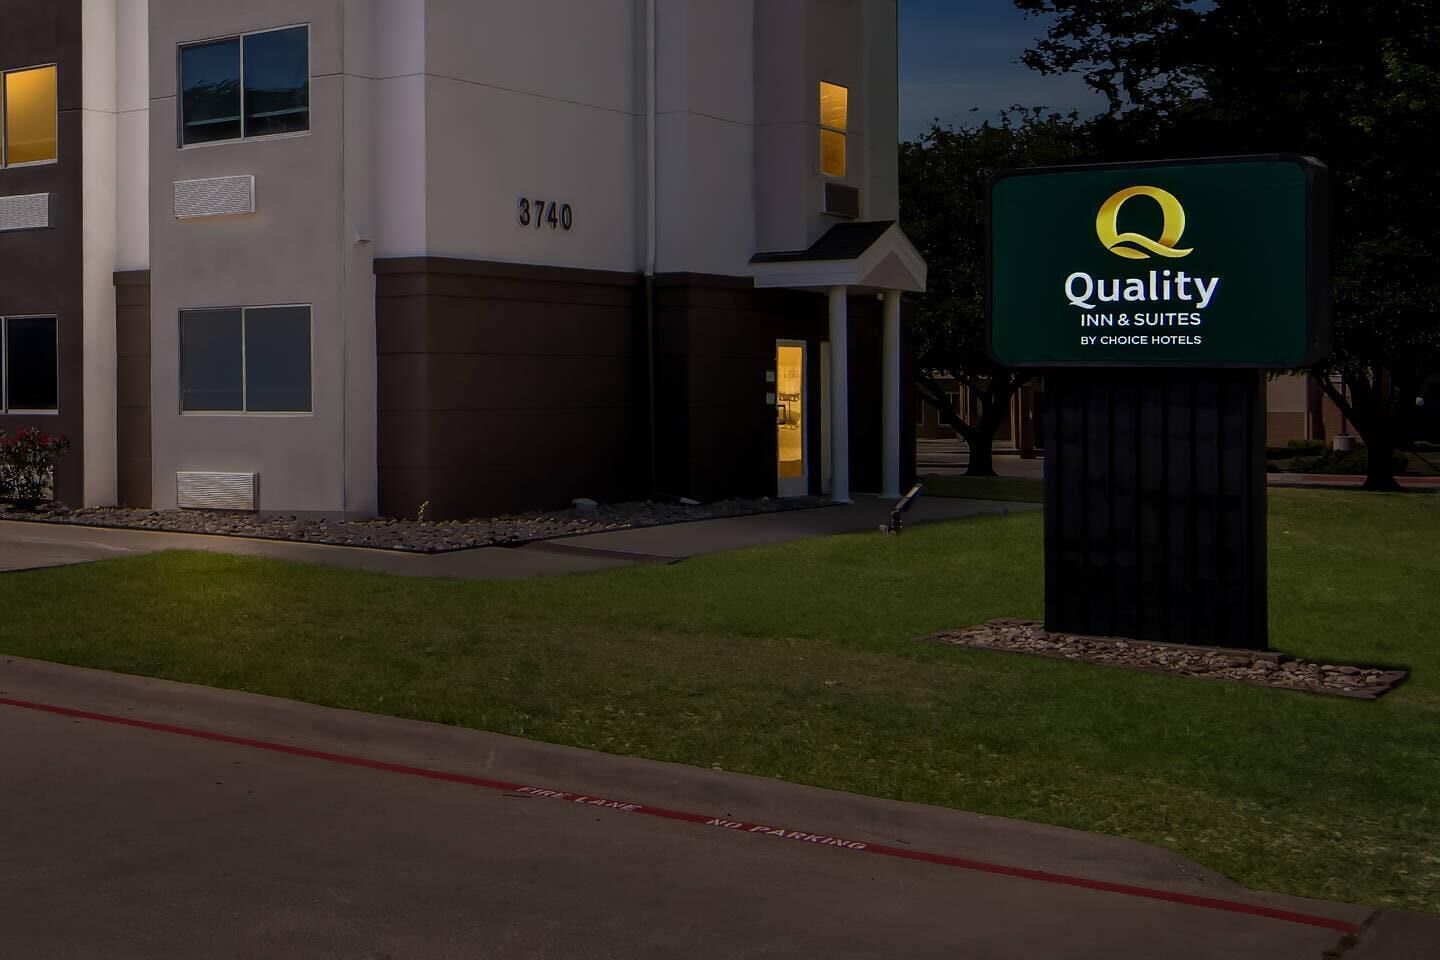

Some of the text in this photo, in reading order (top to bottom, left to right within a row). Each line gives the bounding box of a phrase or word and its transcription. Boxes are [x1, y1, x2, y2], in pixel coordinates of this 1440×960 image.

[519, 198, 573, 230] 3740
[1064, 270, 1220, 310] Quality
[1080, 312, 1202, 327] INN & SUITES
[1080, 335, 1202, 345] BY CHOICE HOTELS
[516, 786, 642, 811] FIRE LANE
[706, 818, 867, 850] NO PARKING
